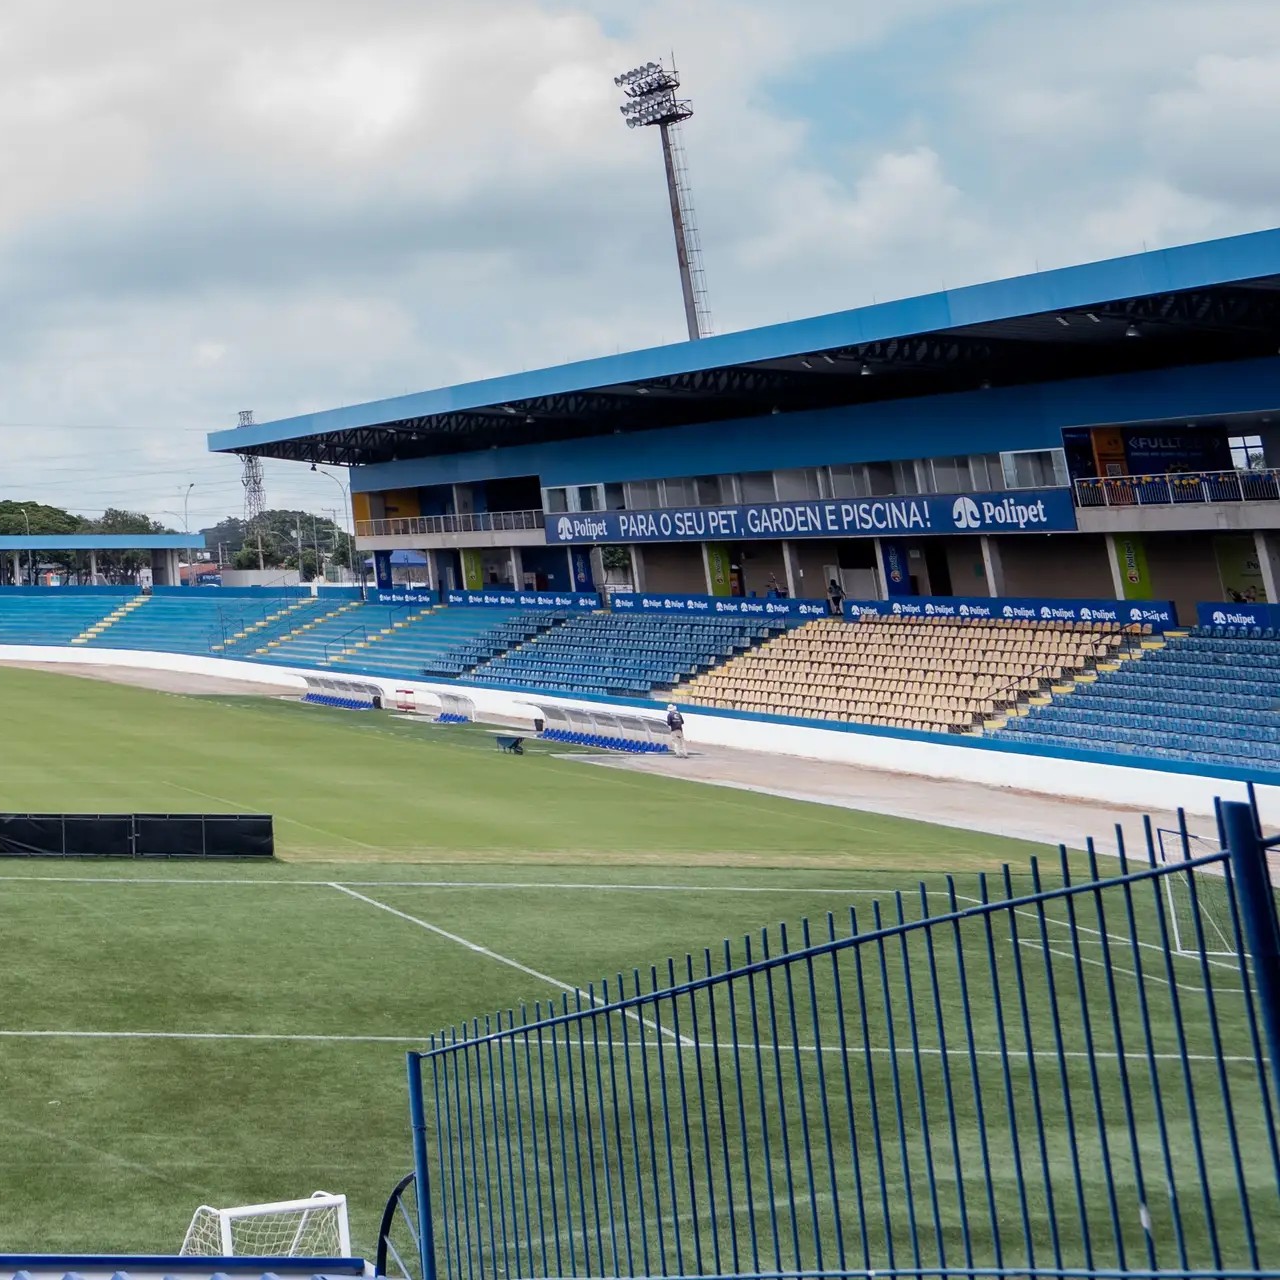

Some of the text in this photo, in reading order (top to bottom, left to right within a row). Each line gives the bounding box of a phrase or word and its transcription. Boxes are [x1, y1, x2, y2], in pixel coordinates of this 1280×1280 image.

[620, 514, 658, 537] PARA
[660, 514, 671, 536] O
[675, 512, 705, 535] SEU
[747, 506, 821, 532] GARDEN
[825, 505, 839, 530] E
[841, 501, 931, 529] PISCINA!
[982, 498, 1047, 528] Polipet
[573, 520, 608, 539] Polipet
[773, 604, 789, 614] Polipet
[901, 604, 921, 614] Polipet
[935, 605, 955, 615] Polipet
[969, 605, 990, 616] Polipet
[1013, 607, 1035, 617] Polipet
[1051, 608, 1075, 619] Polipet
[1091, 609, 1117, 620] Polipet
[1227, 613, 1256, 625] Polipet
